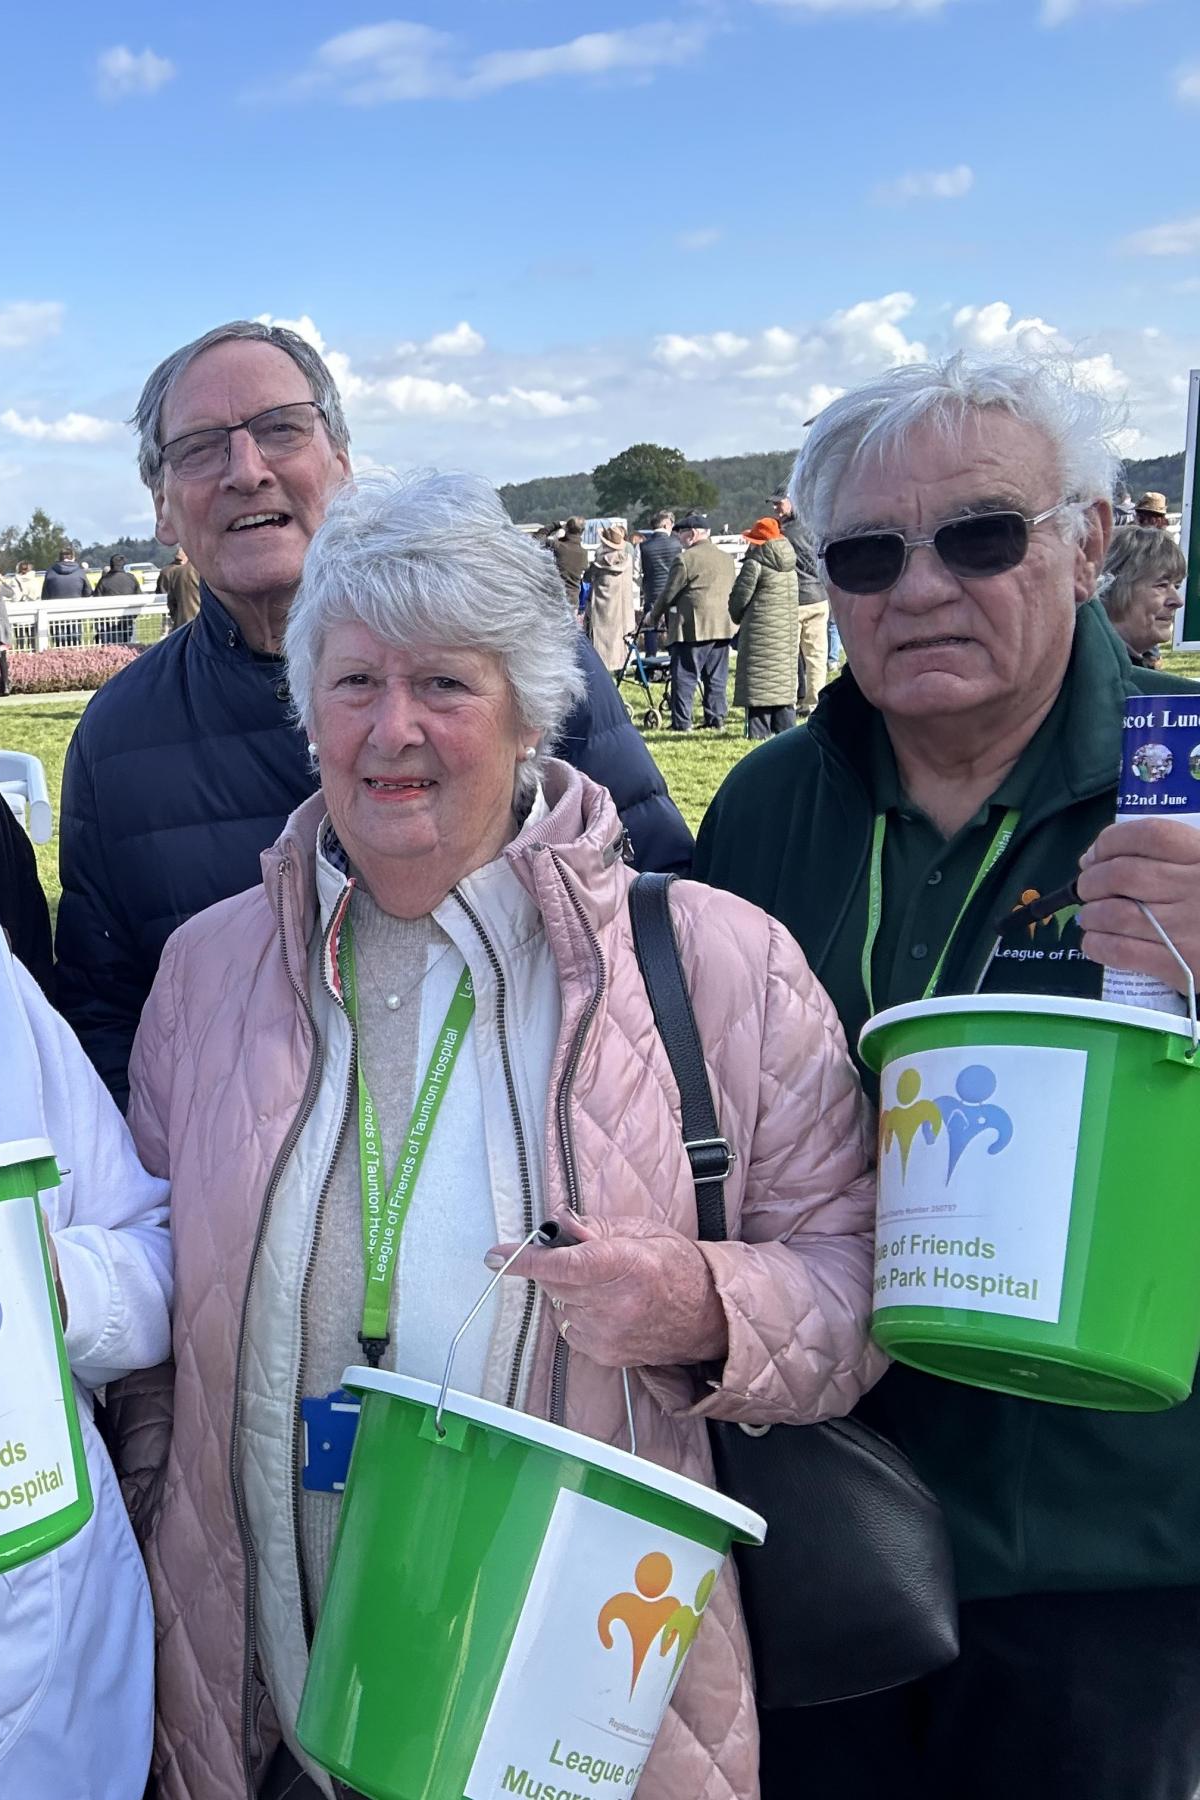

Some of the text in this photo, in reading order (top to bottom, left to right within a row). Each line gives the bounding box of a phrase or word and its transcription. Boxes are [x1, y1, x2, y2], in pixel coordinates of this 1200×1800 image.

[1122, 712, 1156, 729] scot
[1125, 794, 1157, 805] 22nd
[1160, 794, 1188, 805] June
[994, 948, 1045, 961] League
[1049, 949, 1064, 960] of
[365, 1097, 376, 1138] riends
[366, 1142, 380, 1156] of
[372, 1028, 459, 1282] League of Friends of Taunton Hospital
[367, 1159, 380, 1214] Taunton
[891, 1234, 907, 1257] of
[910, 1234, 995, 1260] Friends
[889, 1266, 927, 1288] Park
[933, 1266, 1038, 1300] Hospital
[548, 1739, 625, 1784] League
